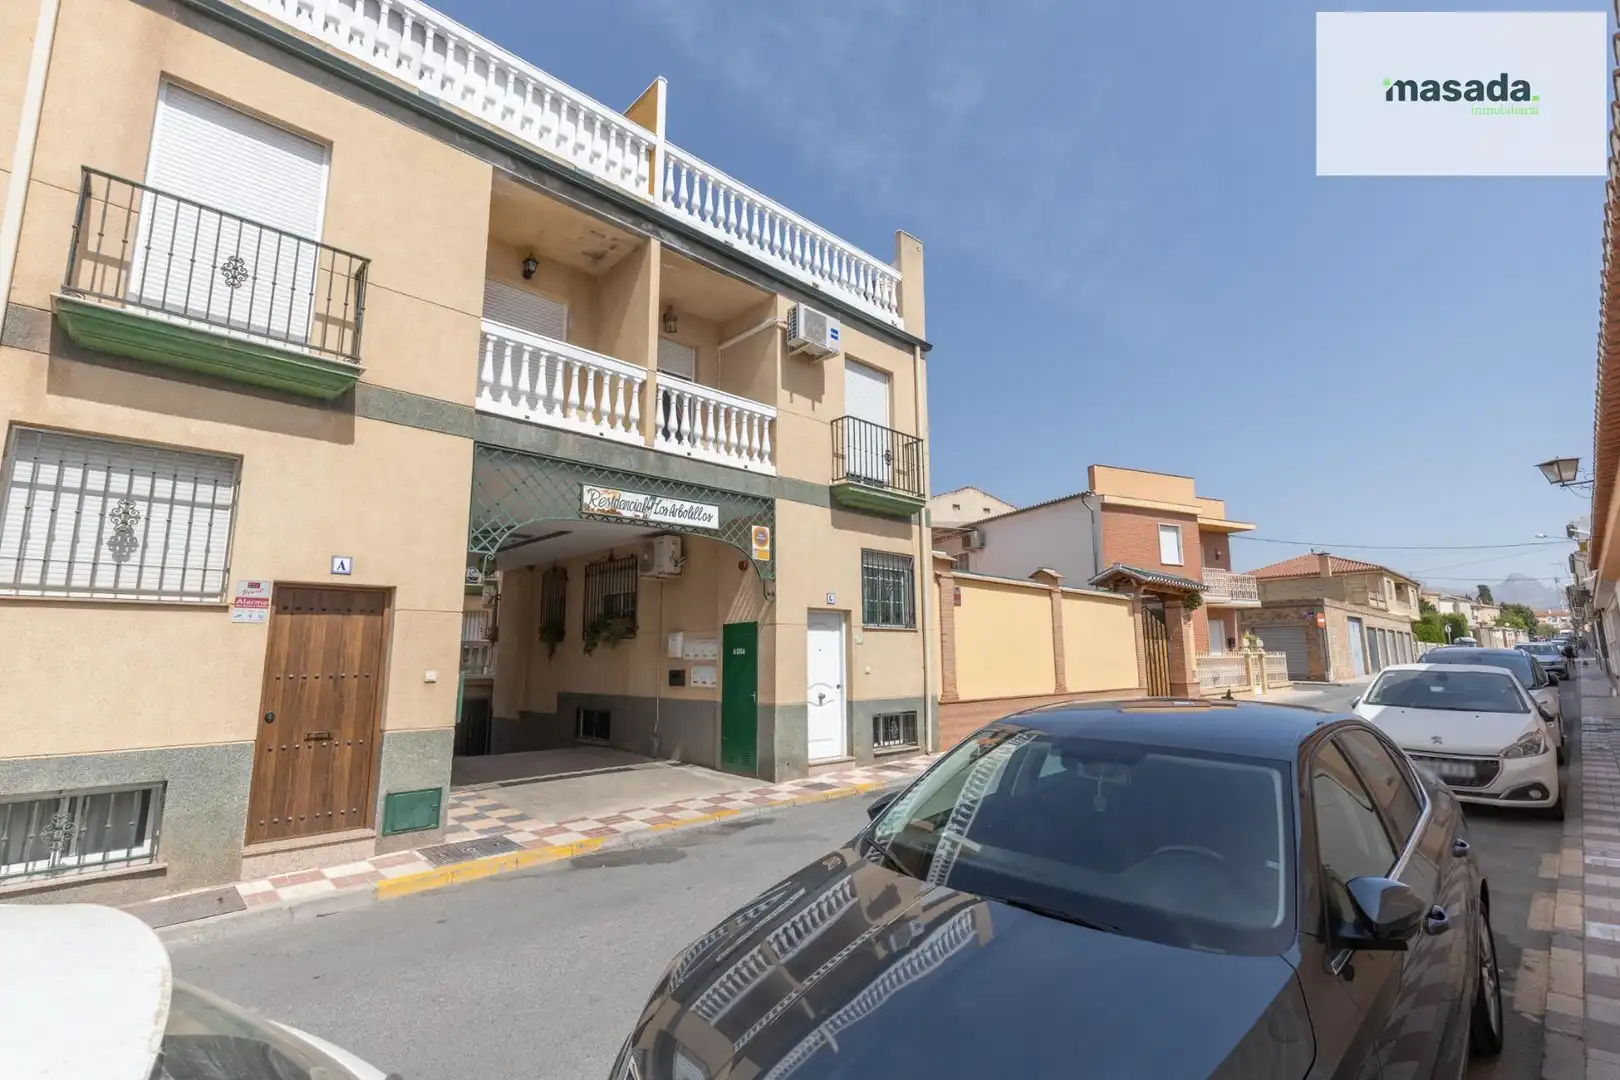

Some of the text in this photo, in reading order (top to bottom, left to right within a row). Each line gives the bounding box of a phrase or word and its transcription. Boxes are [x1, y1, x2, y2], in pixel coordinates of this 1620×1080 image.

[587, 488, 713, 522] Residencial Los Arbolillos
[336, 560, 346, 571] A
